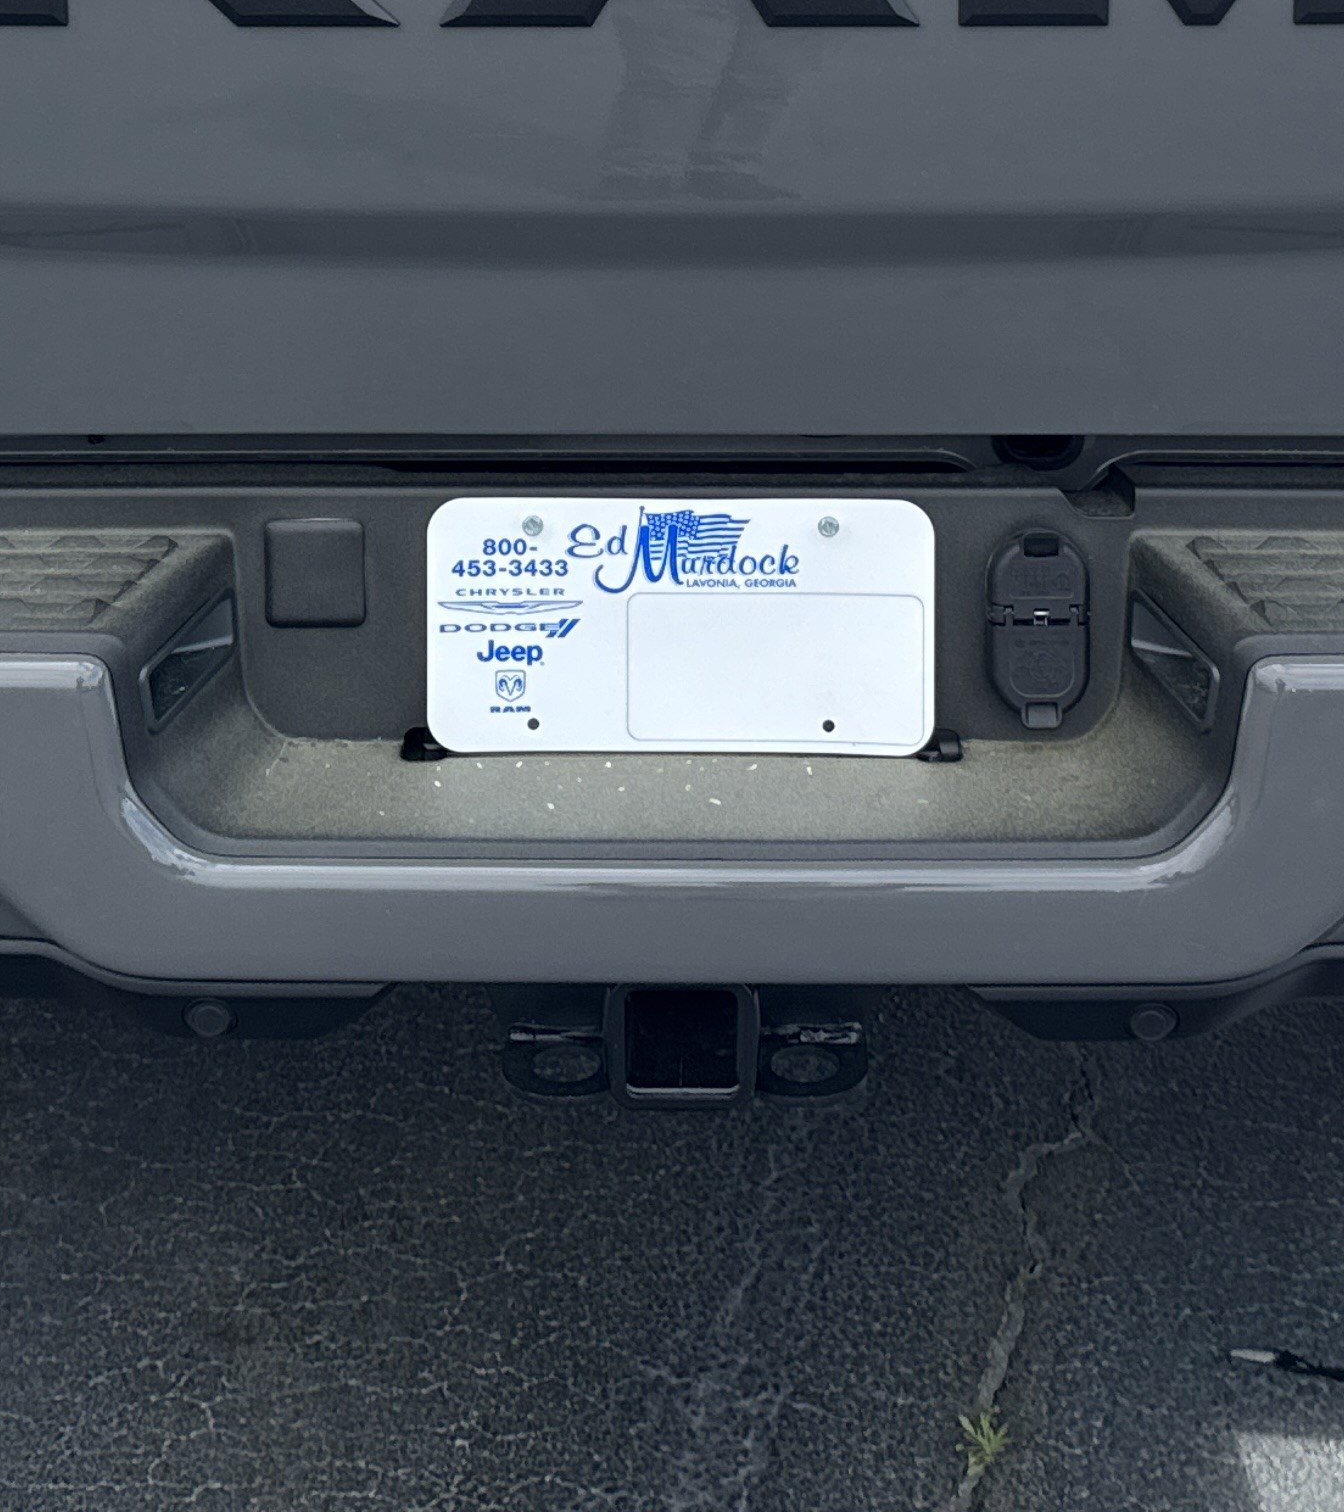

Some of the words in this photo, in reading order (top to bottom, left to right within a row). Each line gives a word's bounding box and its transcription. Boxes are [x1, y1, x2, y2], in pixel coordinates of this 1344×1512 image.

[482, 538, 538, 556] 800-
[565, 523, 628, 559] Ed
[593, 523, 800, 594] Murdock
[451, 559, 569, 577] 453-3433
[455, 588, 566, 596] CHRYSLER
[686, 578, 740, 589] LAVONIA,
[744, 578, 797, 589] GEORGIA
[439, 623, 561, 634] DODGE
[476, 639, 544, 666] Jeep
[490, 706, 532, 714] RAM
